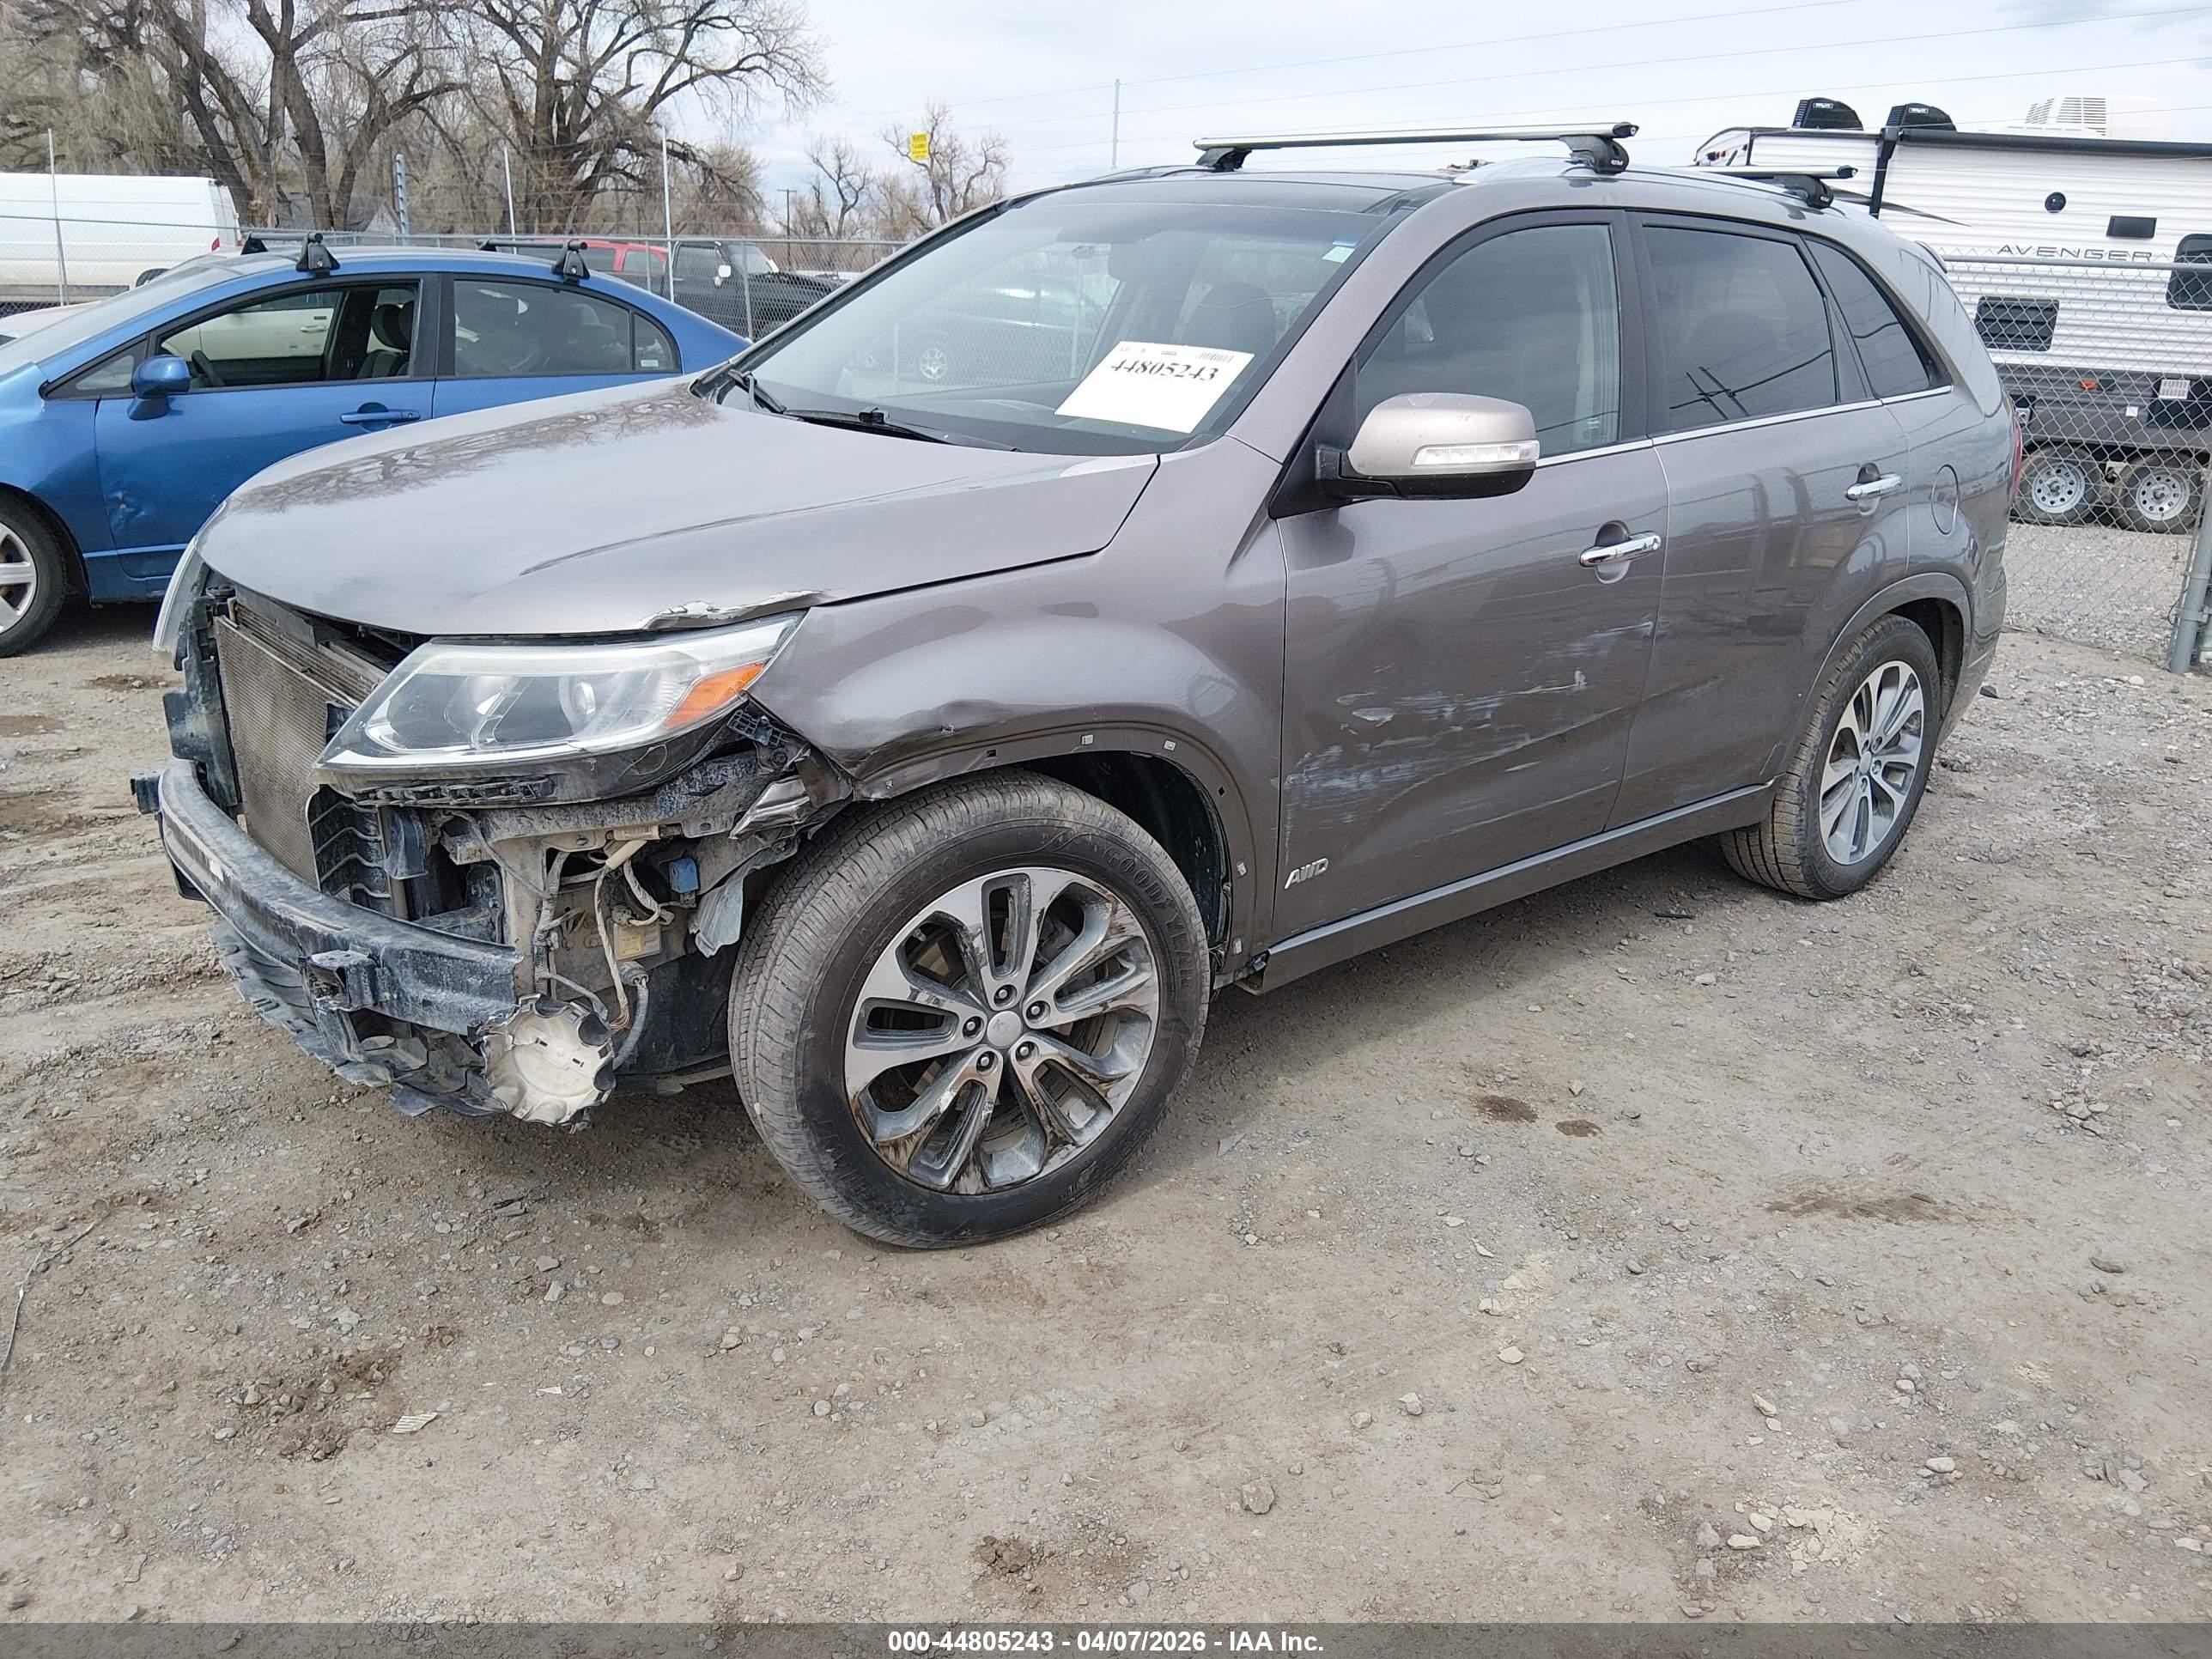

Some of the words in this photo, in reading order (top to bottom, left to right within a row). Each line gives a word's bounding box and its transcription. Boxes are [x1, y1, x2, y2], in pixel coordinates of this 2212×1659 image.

[1996, 244, 2153, 263] AVENGER
[1110, 358, 1219, 381] 44805243
[1284, 857, 1329, 890] AWD
